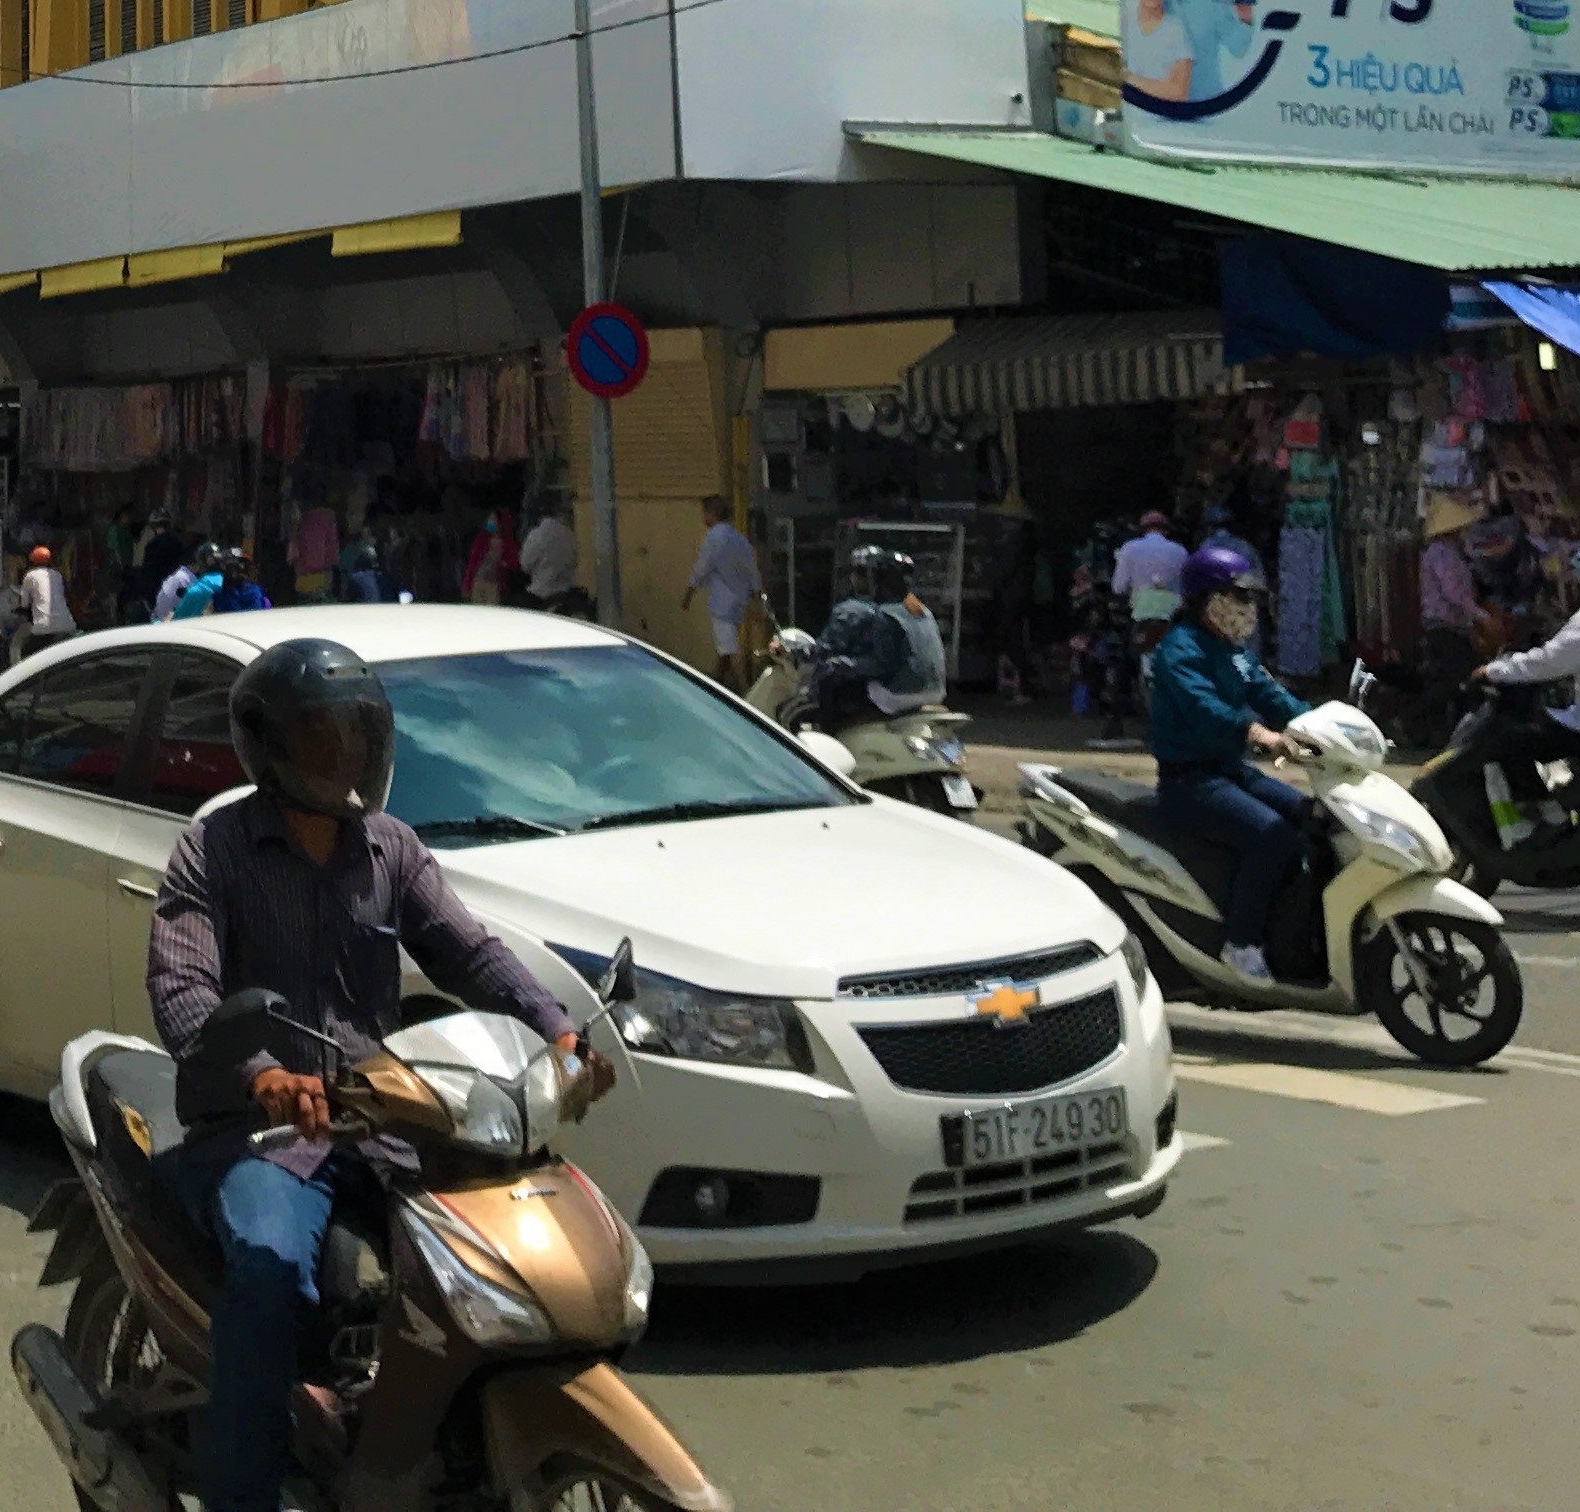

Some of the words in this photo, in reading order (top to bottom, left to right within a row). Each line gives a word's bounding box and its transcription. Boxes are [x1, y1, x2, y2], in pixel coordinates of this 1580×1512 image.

[1306, 44, 1331, 89] 3
[1336, 51, 1399, 94] HIỆU
[1277, 100, 1351, 129] TRONG
